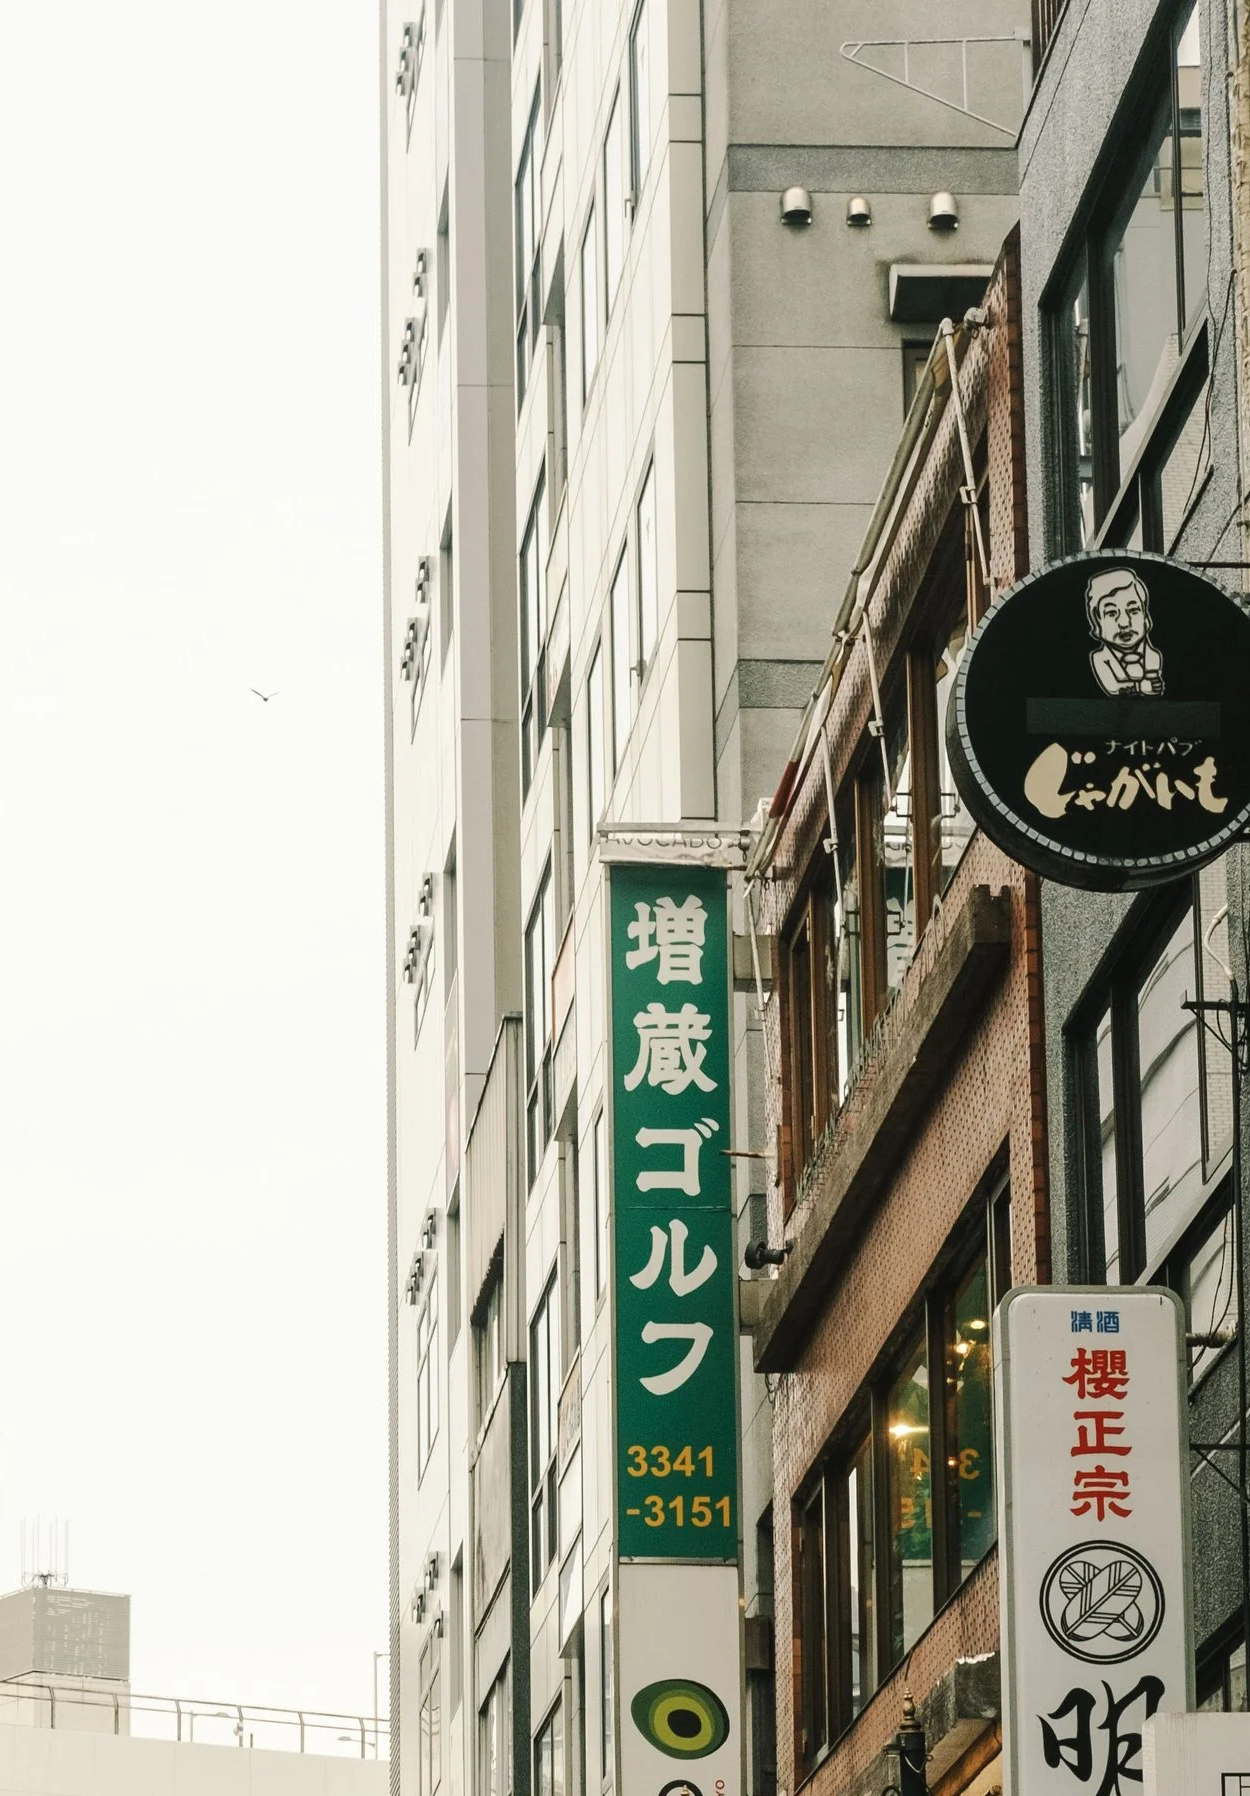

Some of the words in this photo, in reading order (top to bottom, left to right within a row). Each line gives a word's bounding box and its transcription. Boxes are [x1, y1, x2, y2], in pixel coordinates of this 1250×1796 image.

[1105, 736, 1202, 756] ナイトパブ
[1024, 743, 1228, 819] じゃがいも
[623, 893, 719, 1397] 増蔵ゴルフ
[1070, 1310, 1120, 1334] 清酒
[1061, 1347, 1132, 1523] 櫻正宗
[626, 1445, 715, 1479] 3341
[626, 1495, 733, 1529] -3151
